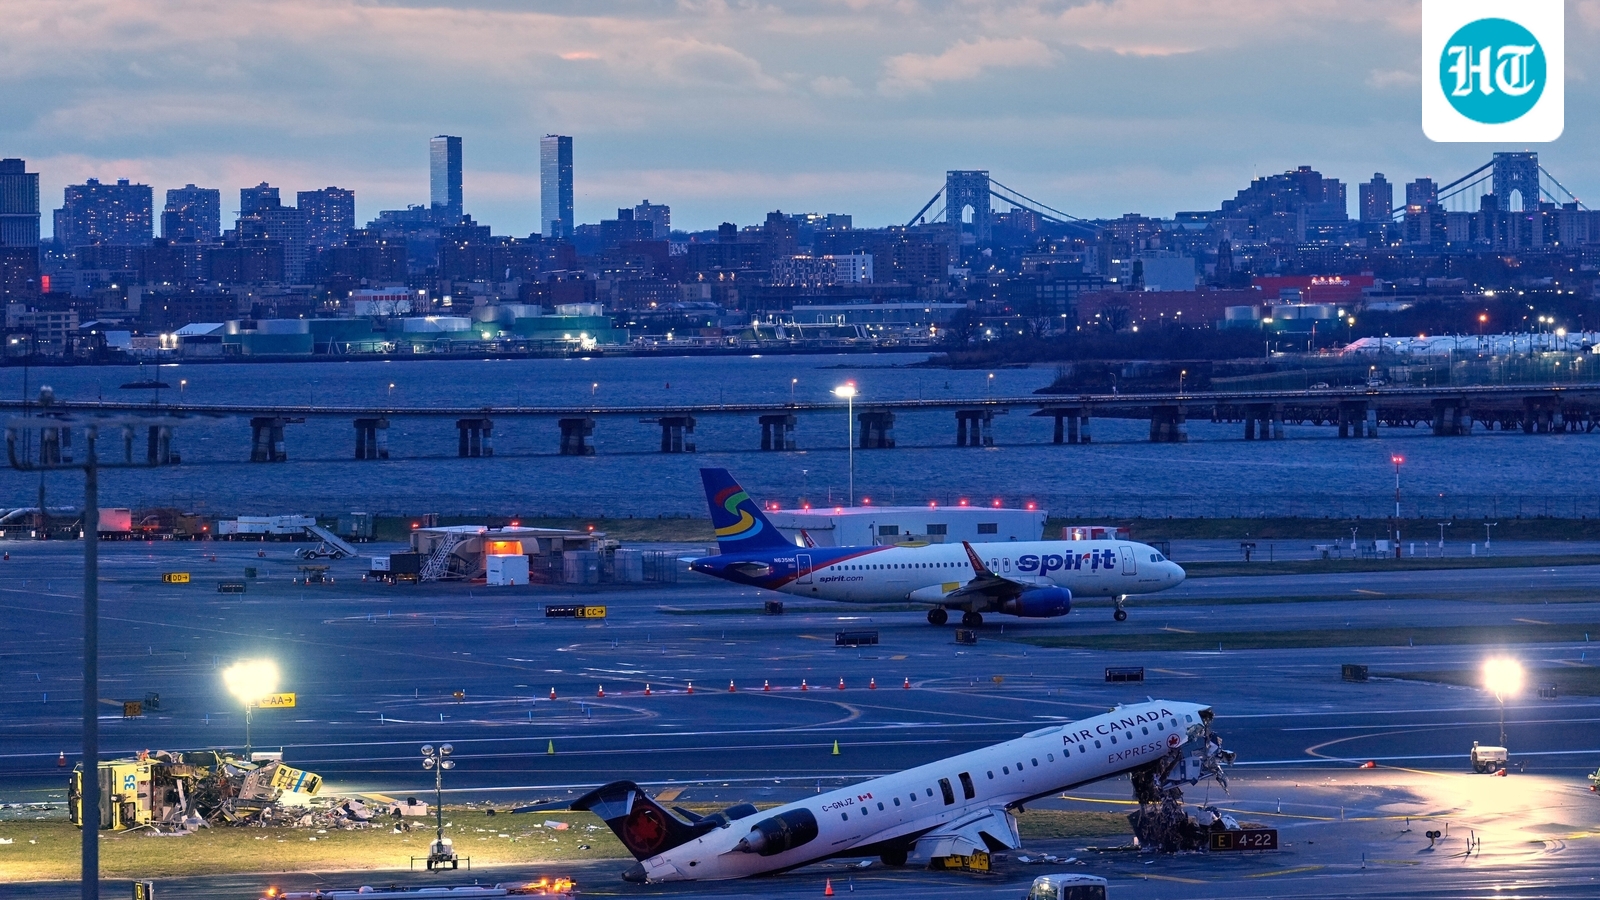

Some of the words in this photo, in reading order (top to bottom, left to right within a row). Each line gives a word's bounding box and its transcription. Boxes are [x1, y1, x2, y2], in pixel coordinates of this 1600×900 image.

[1329, 278, 1350, 287] Storage
[1018, 549, 1116, 577] spirit
[172, 574, 182, 582] DD
[819, 575, 864, 584] spirit.com
[577, 608, 583, 616] E
[586, 608, 597, 616] CC
[270, 696, 284, 705] AA
[1062, 729, 1093, 746] AIR
[1096, 708, 1173, 735] CANADA
[1108, 740, 1163, 764] EXPRESS
[124, 774, 135, 790] 35
[821, 797, 855, 812] C-GNJZ
[1218, 835, 1226, 847] E
[1239, 833, 1271, 847] 4-22
